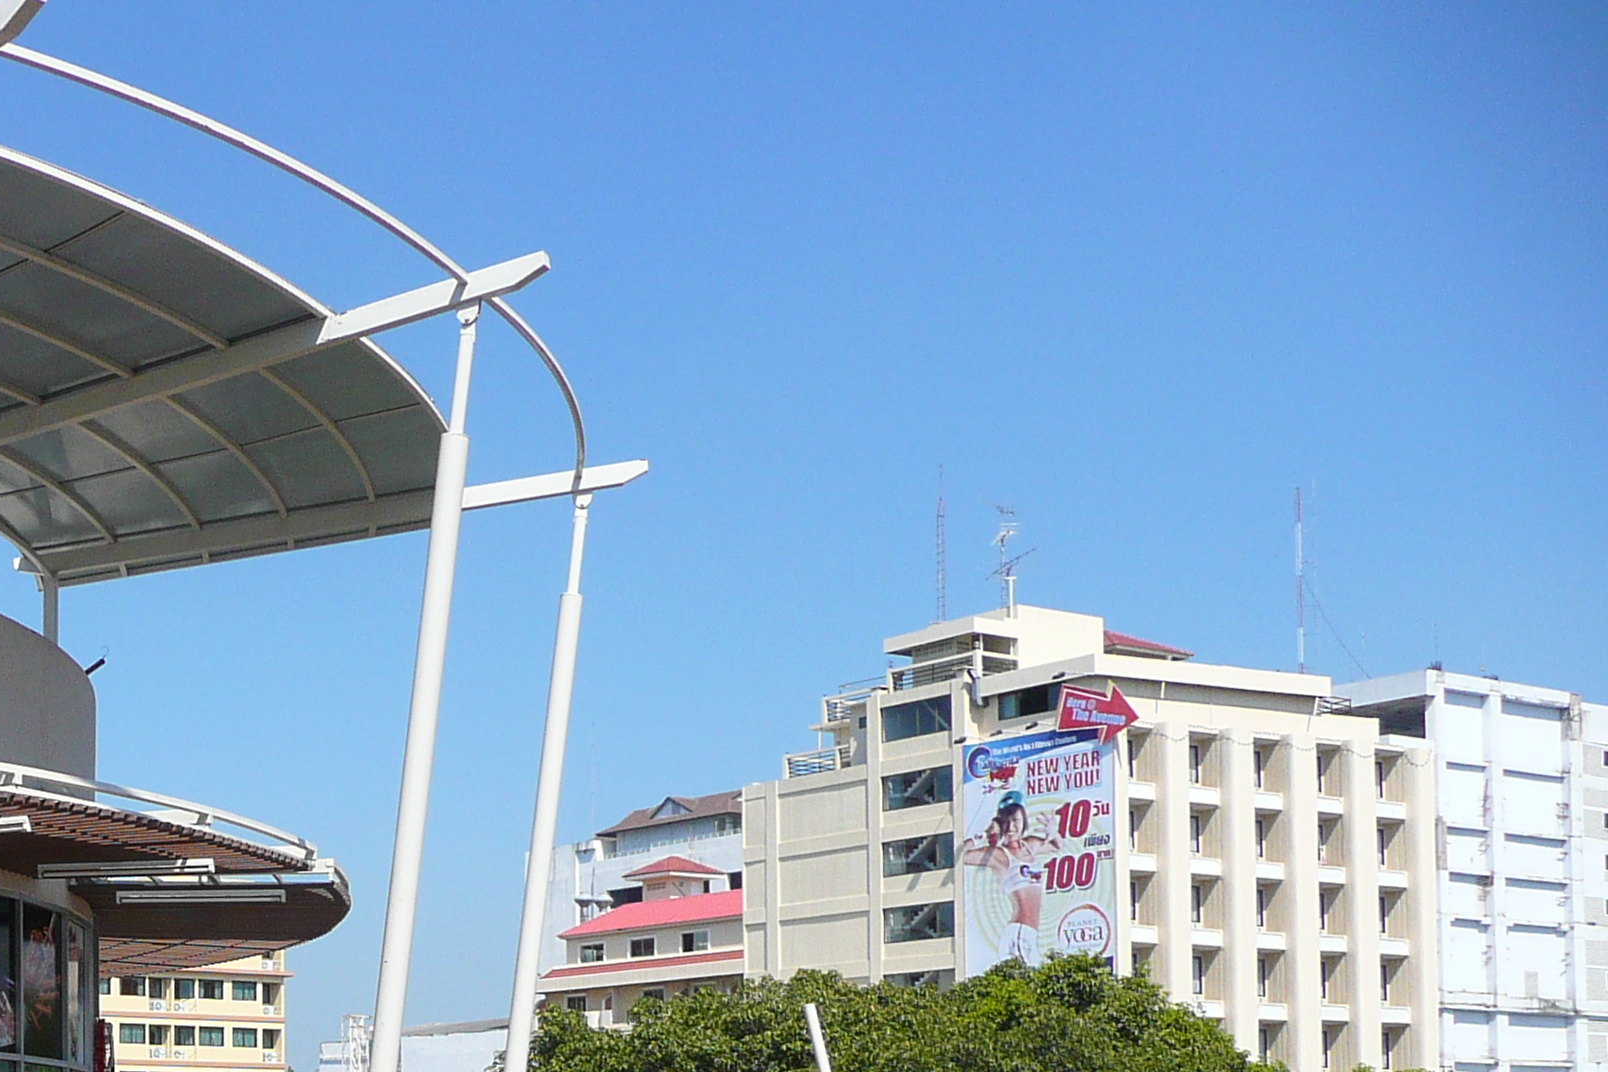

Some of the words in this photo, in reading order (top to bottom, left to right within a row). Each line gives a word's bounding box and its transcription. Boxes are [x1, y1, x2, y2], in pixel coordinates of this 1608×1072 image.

[1072, 707, 1089, 722] The
[1089, 710, 1126, 726] Avenue
[1027, 757, 1059, 778] NEW
[1063, 750, 1101, 771] YEAR
[1027, 775, 1060, 796] NEW
[1063, 770, 1101, 790] YOU!
[1055, 799, 1092, 839] 10
[1044, 852, 1096, 891] 100
